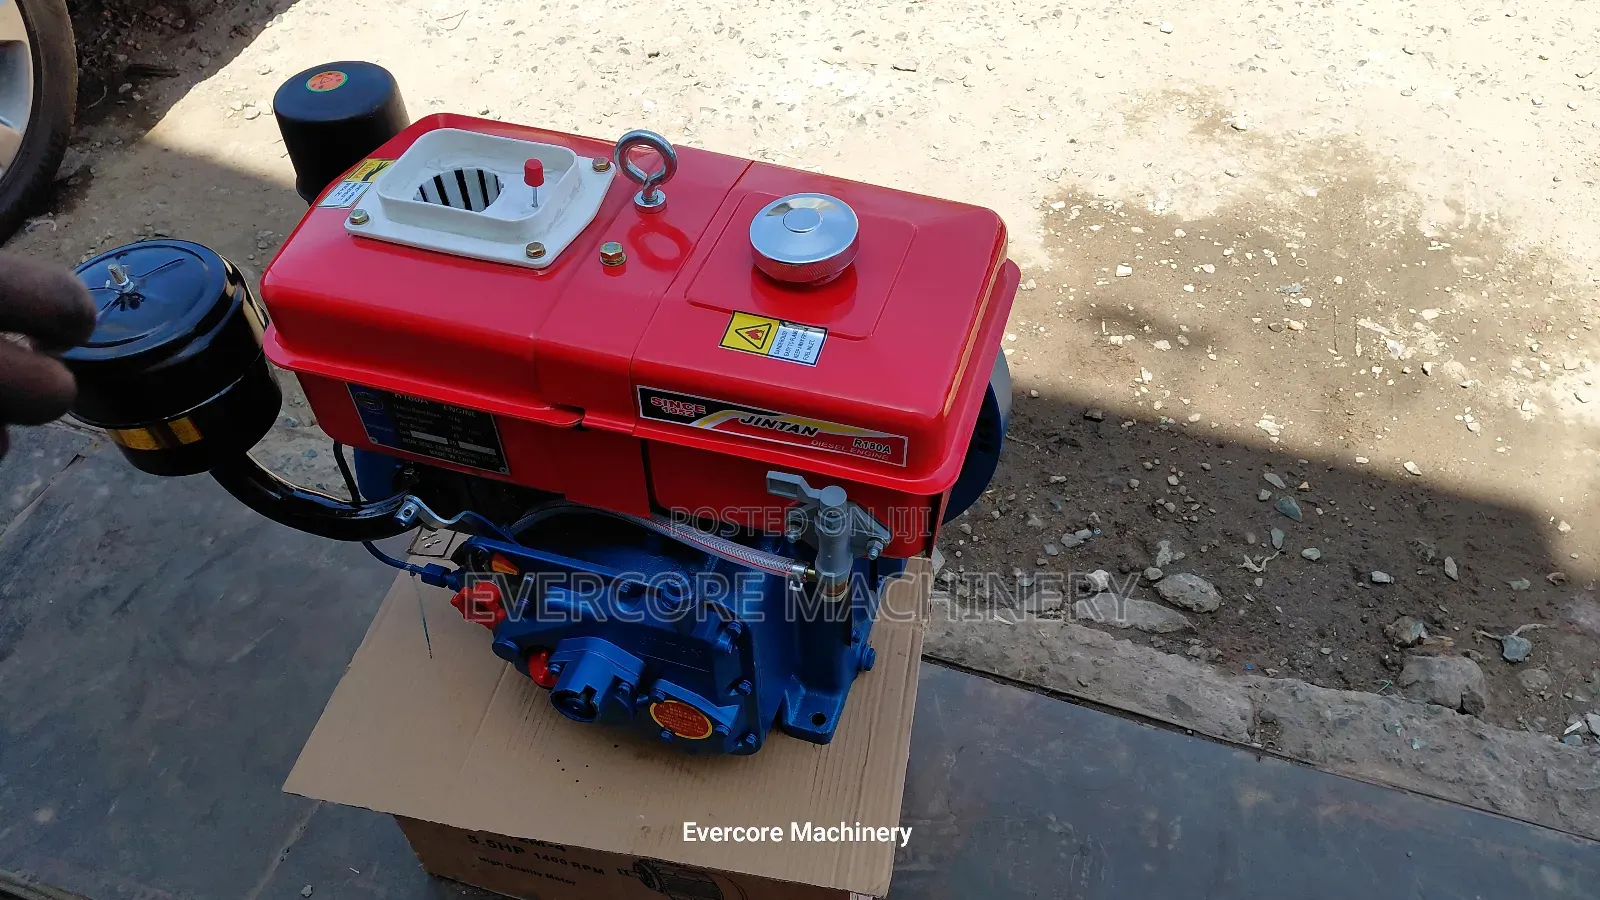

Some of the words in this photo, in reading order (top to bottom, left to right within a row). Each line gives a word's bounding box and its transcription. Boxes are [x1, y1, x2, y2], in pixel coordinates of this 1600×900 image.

[442, 404, 477, 418] ENGINE
[651, 397, 706, 414] SINCE
[739, 415, 819, 437] JINTAN
[811, 439, 847, 452] DIESEL
[849, 447, 889, 461] ENGINE
[853, 438, 891, 454] R180A
[467, 834, 525, 854] 5.5HP
[534, 852, 568, 865] 1400
[570, 861, 605, 875] RPM
[478, 856, 504, 867] High
[505, 863, 543, 877] Quality
[544, 873, 577, 886] Motor
